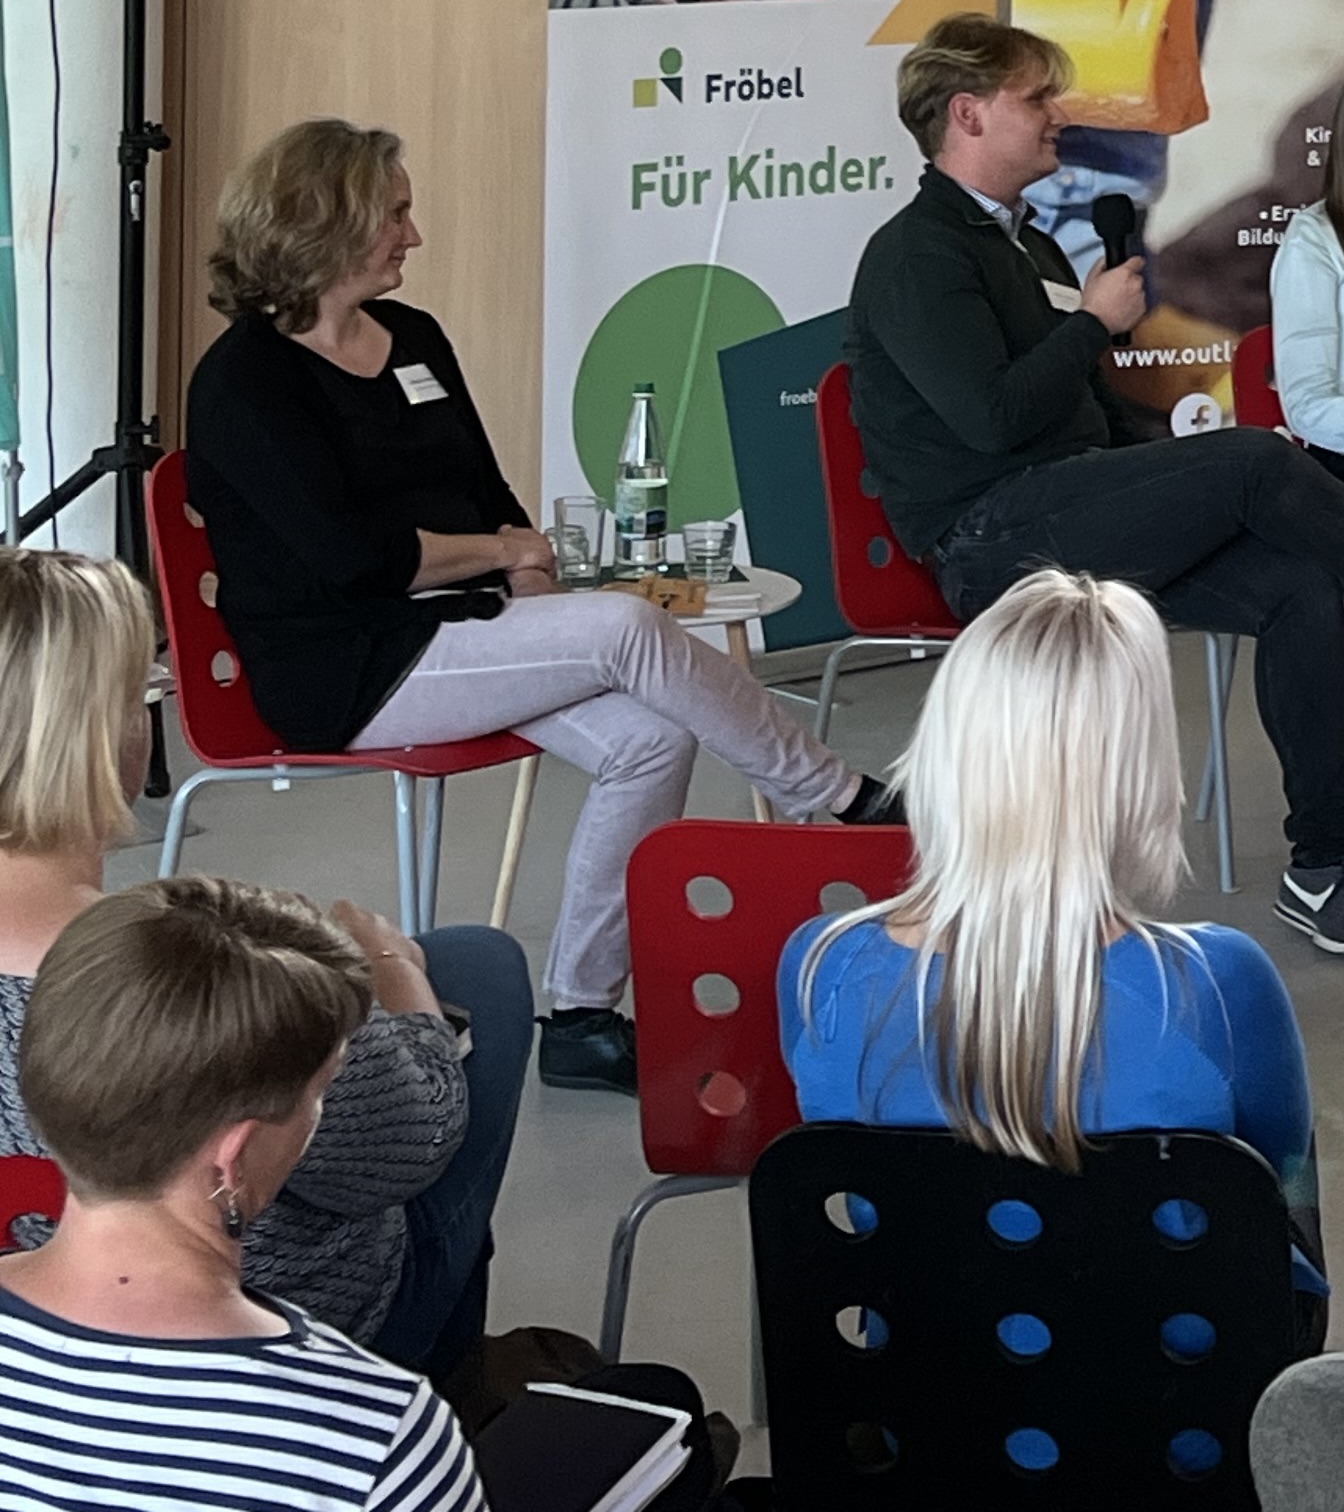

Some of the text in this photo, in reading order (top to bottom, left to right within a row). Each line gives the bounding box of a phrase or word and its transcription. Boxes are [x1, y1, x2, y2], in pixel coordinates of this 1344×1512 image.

[704, 67, 805, 103] Fröbel
[631, 145, 894, 210] Für Kinder.
[1113, 340, 1233, 368] www.outl
[780, 388, 818, 406] froeb
